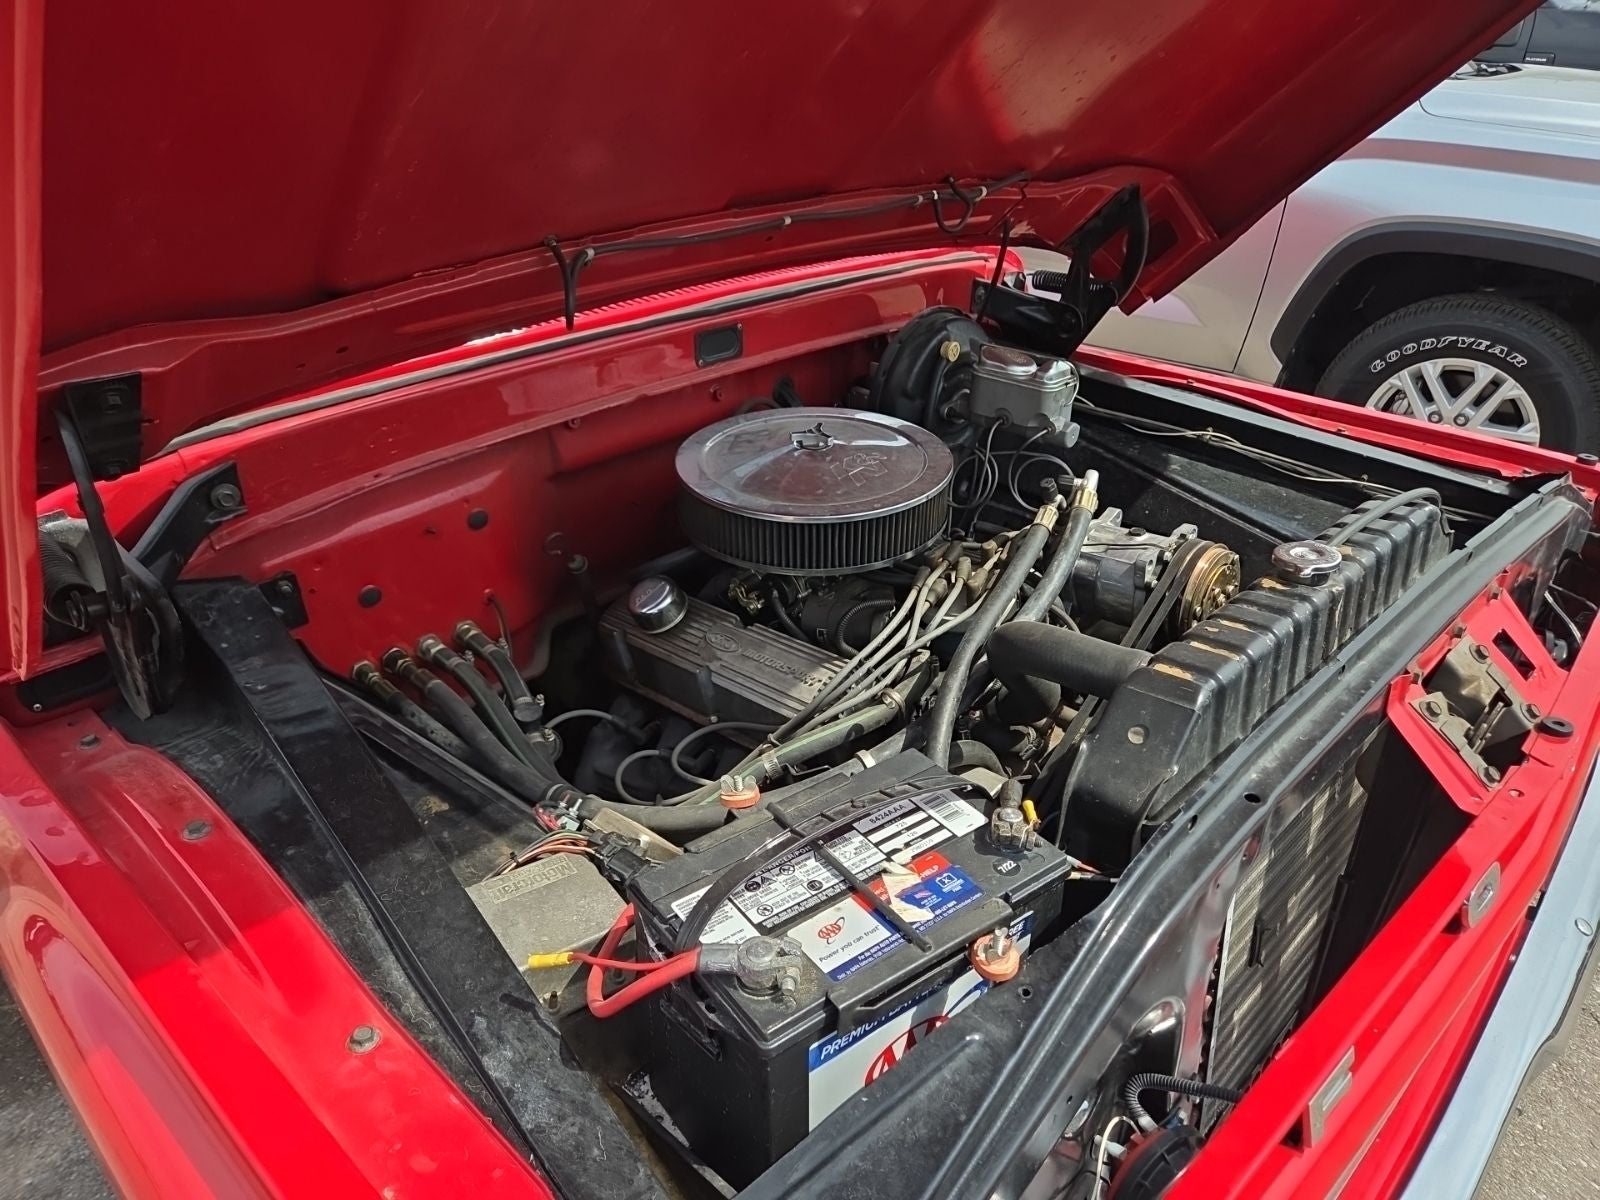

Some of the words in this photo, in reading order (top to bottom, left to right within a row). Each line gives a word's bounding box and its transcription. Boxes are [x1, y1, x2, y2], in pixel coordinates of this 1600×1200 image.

[1371, 336, 1527, 373] GOODYEAR
[744, 648, 822, 687] MOTORSPORT
[818, 924, 841, 939] AAA
[818, 947, 839, 963] Power
[839, 941, 853, 952] you
[851, 934, 864, 944] can
[819, 1016, 886, 1060] PREMIU
